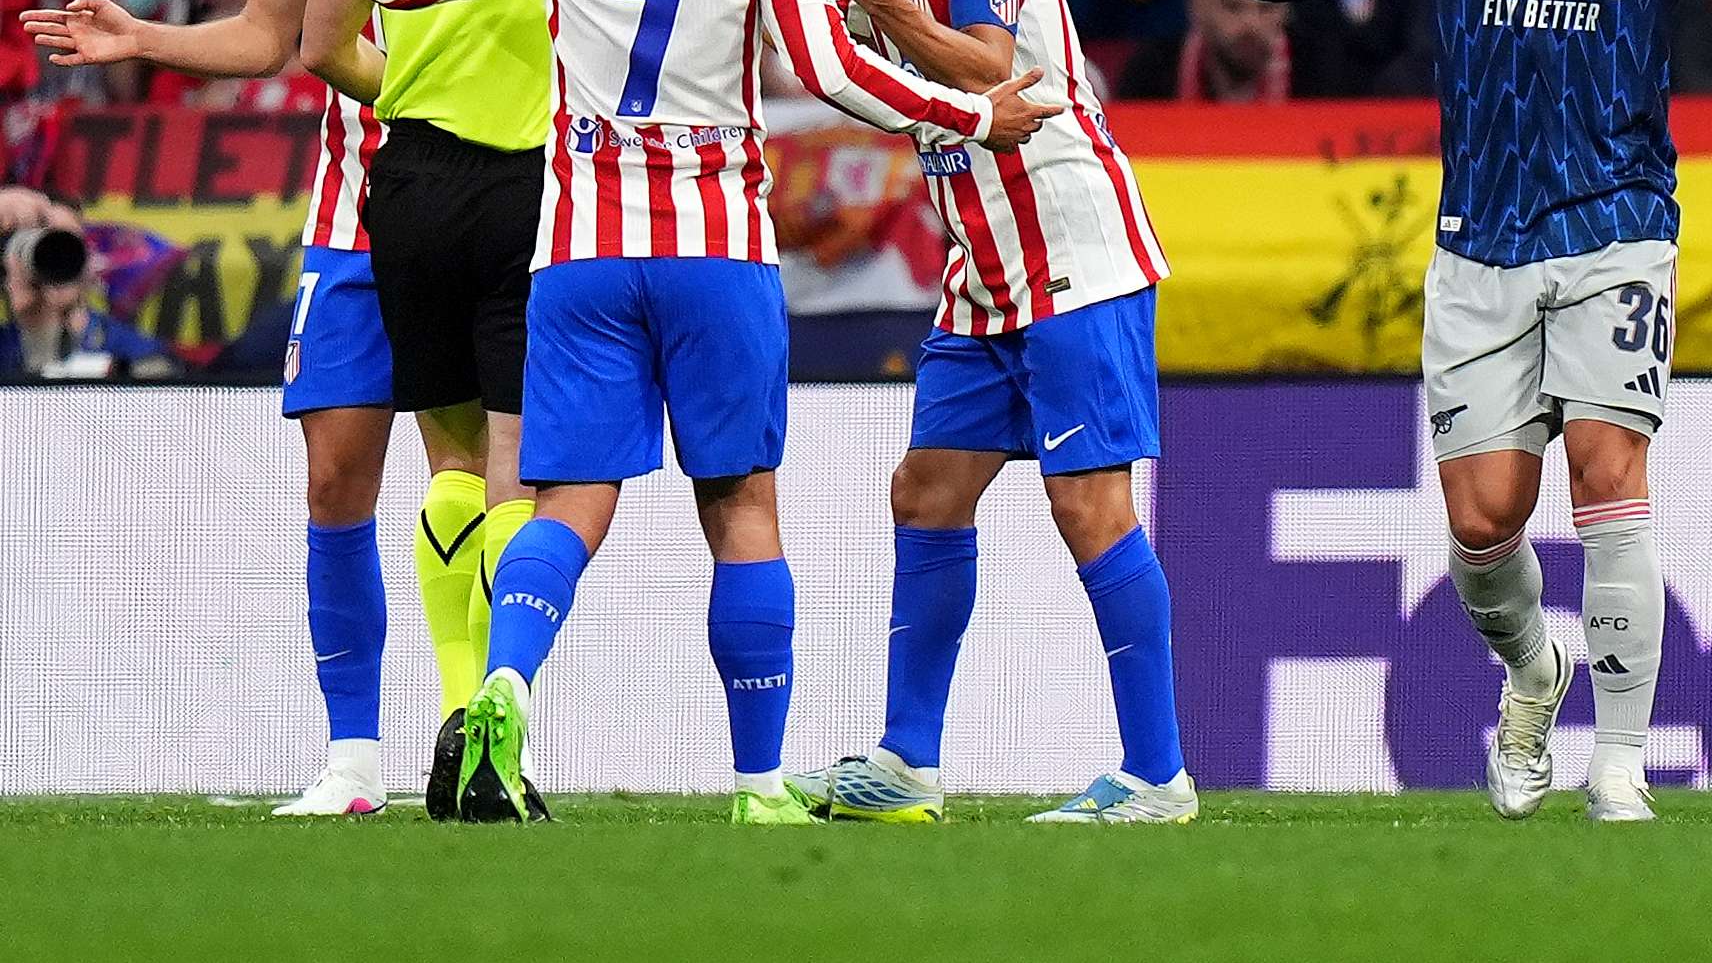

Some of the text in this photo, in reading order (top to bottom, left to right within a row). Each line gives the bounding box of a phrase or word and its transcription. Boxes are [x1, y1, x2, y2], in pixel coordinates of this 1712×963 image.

[1612, 284, 1669, 365] 36
[500, 592, 560, 623] ATLETI
[732, 672, 788, 690] ATLETI
